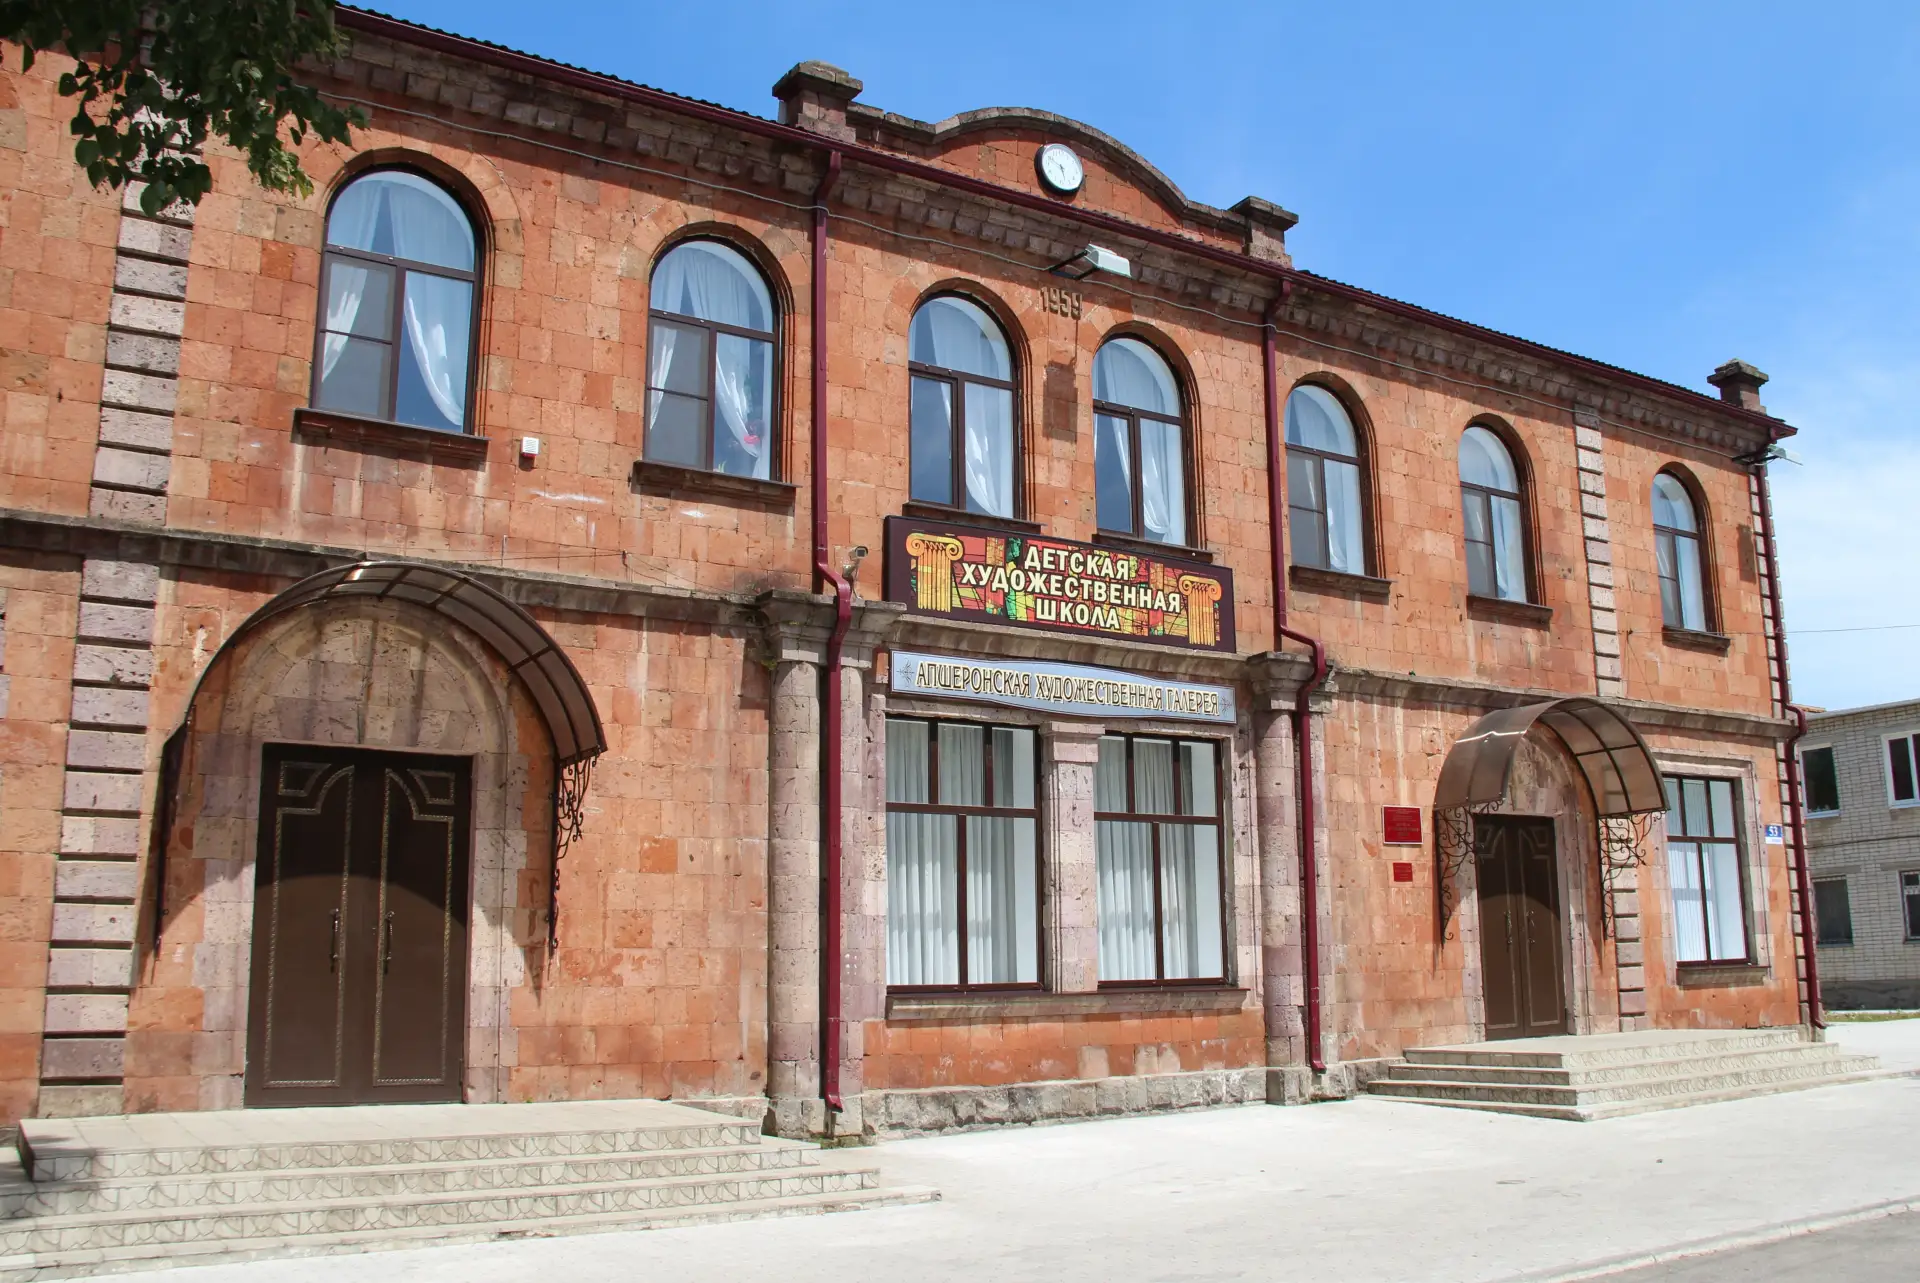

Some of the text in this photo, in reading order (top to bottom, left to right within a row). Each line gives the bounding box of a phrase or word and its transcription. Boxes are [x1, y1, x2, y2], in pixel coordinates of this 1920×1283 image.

[1041, 287, 1082, 320] 1959
[1024, 546, 1130, 580] ДЕТСКАЯ
[961, 562, 1181, 613] ХУДОЖЕСТВЕННАЯ
[1035, 598, 1120, 630] ШКОЛА
[915, 661, 1219, 716] АПШЕРОНСКАЯ ХУДОЖЕСТВЕННАЯ ГАЛЕРЕЯ
[1769, 826, 1778, 837] 53
